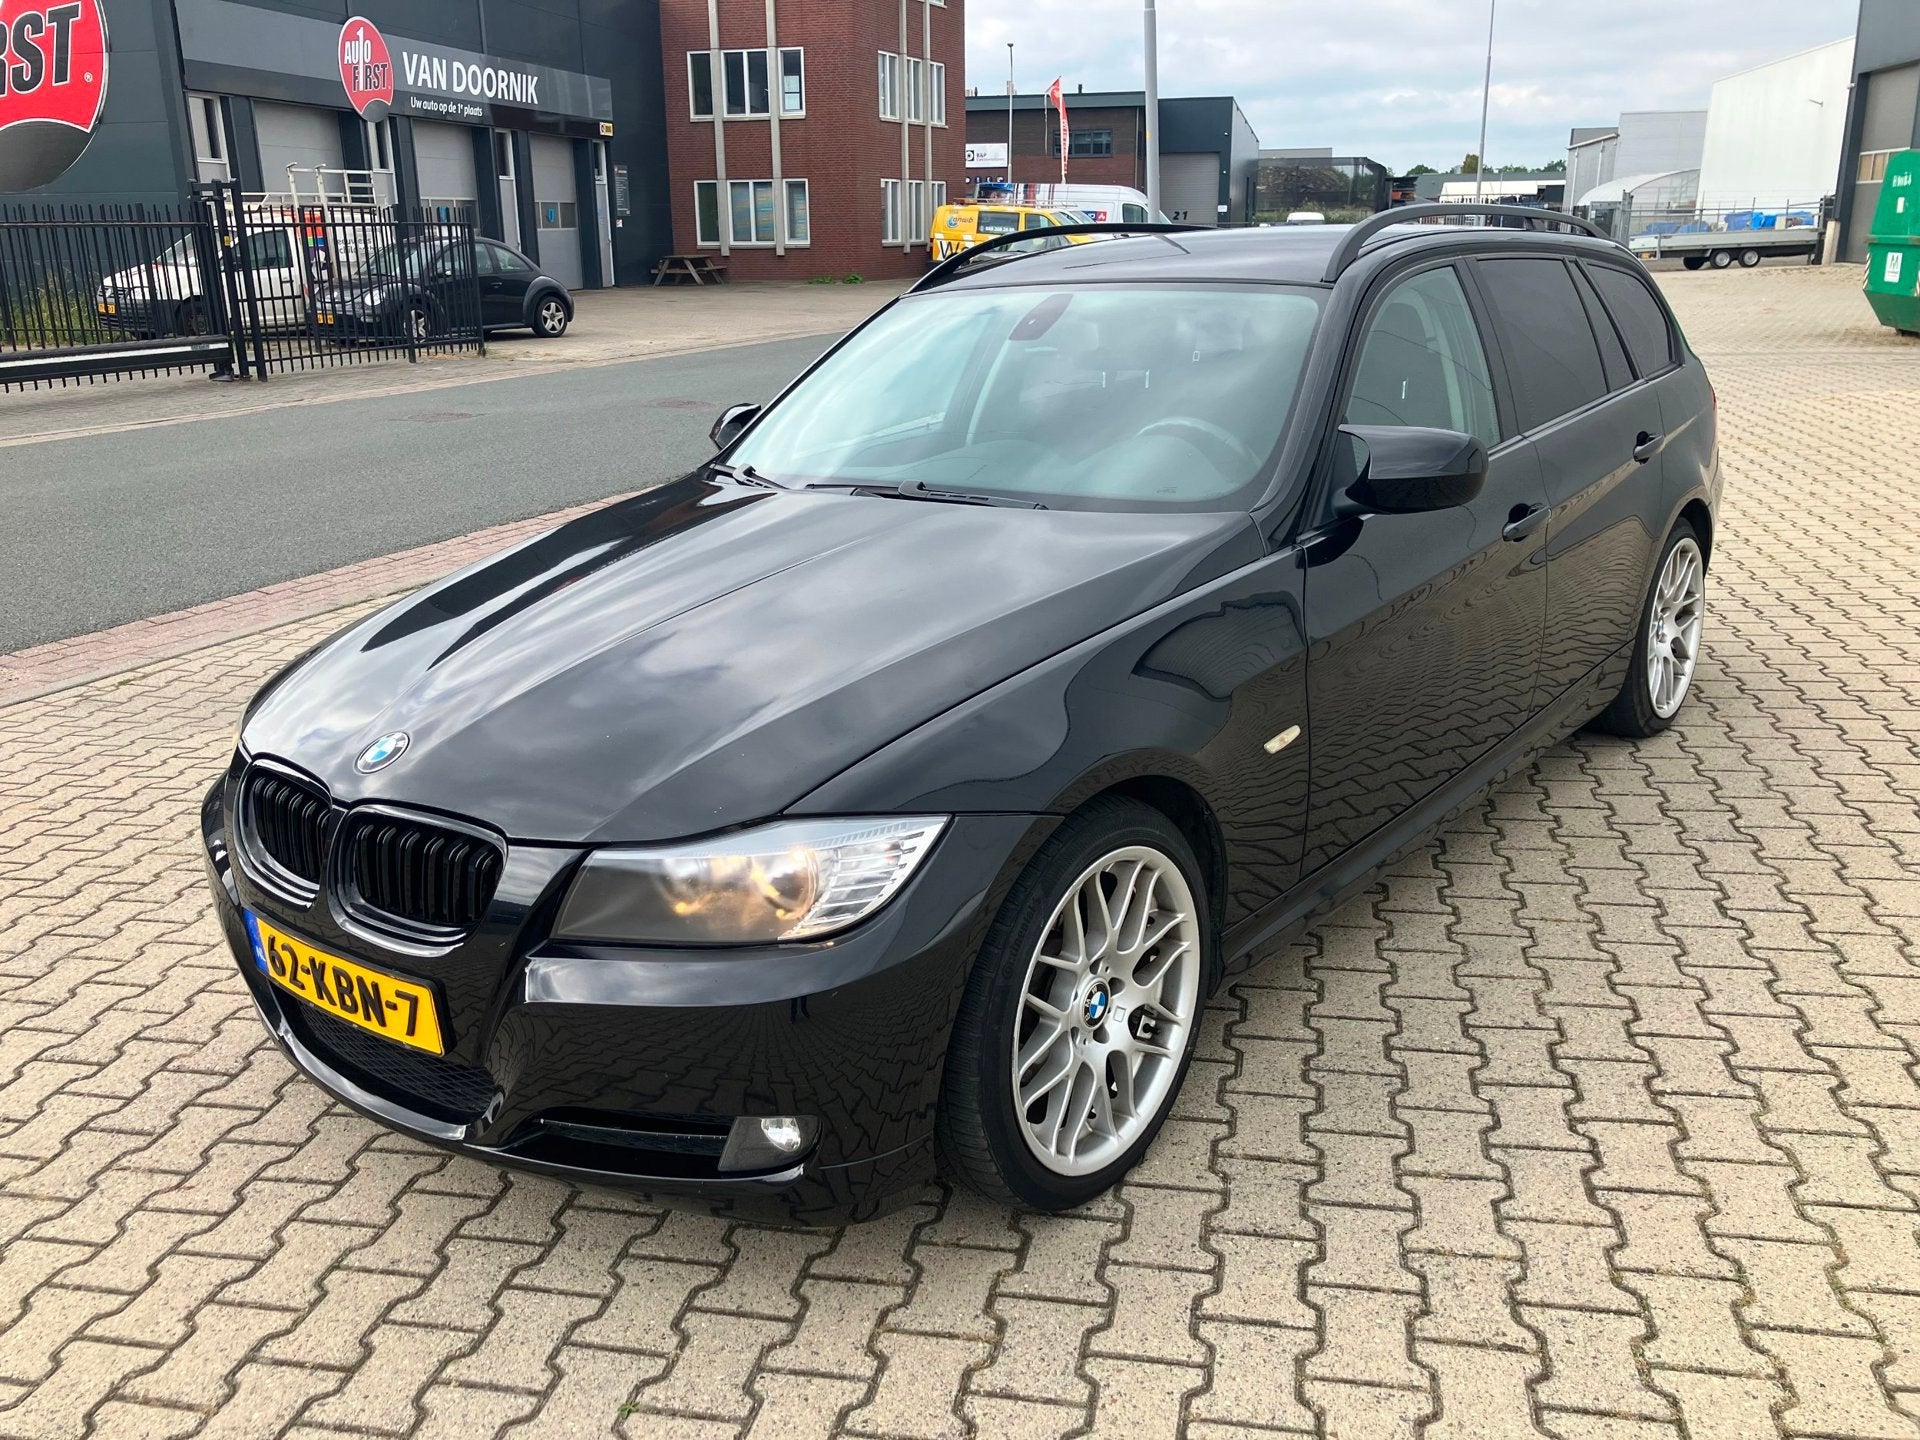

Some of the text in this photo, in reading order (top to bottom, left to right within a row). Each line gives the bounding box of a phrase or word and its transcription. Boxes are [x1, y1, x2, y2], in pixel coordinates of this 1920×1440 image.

[353, 62, 389, 93] FIRST
[402, 51, 538, 104] VAN DOORNIK
[410, 96, 422, 108] Uw
[422, 100, 438, 111] auto
[438, 103, 448, 115] op
[448, 101, 456, 114] de
[463, 104, 483, 117] plaats
[1173, 210, 1188, 220] 21
[255, 945, 267, 962] NL
[268, 934, 419, 1037] 62-KBN-7
